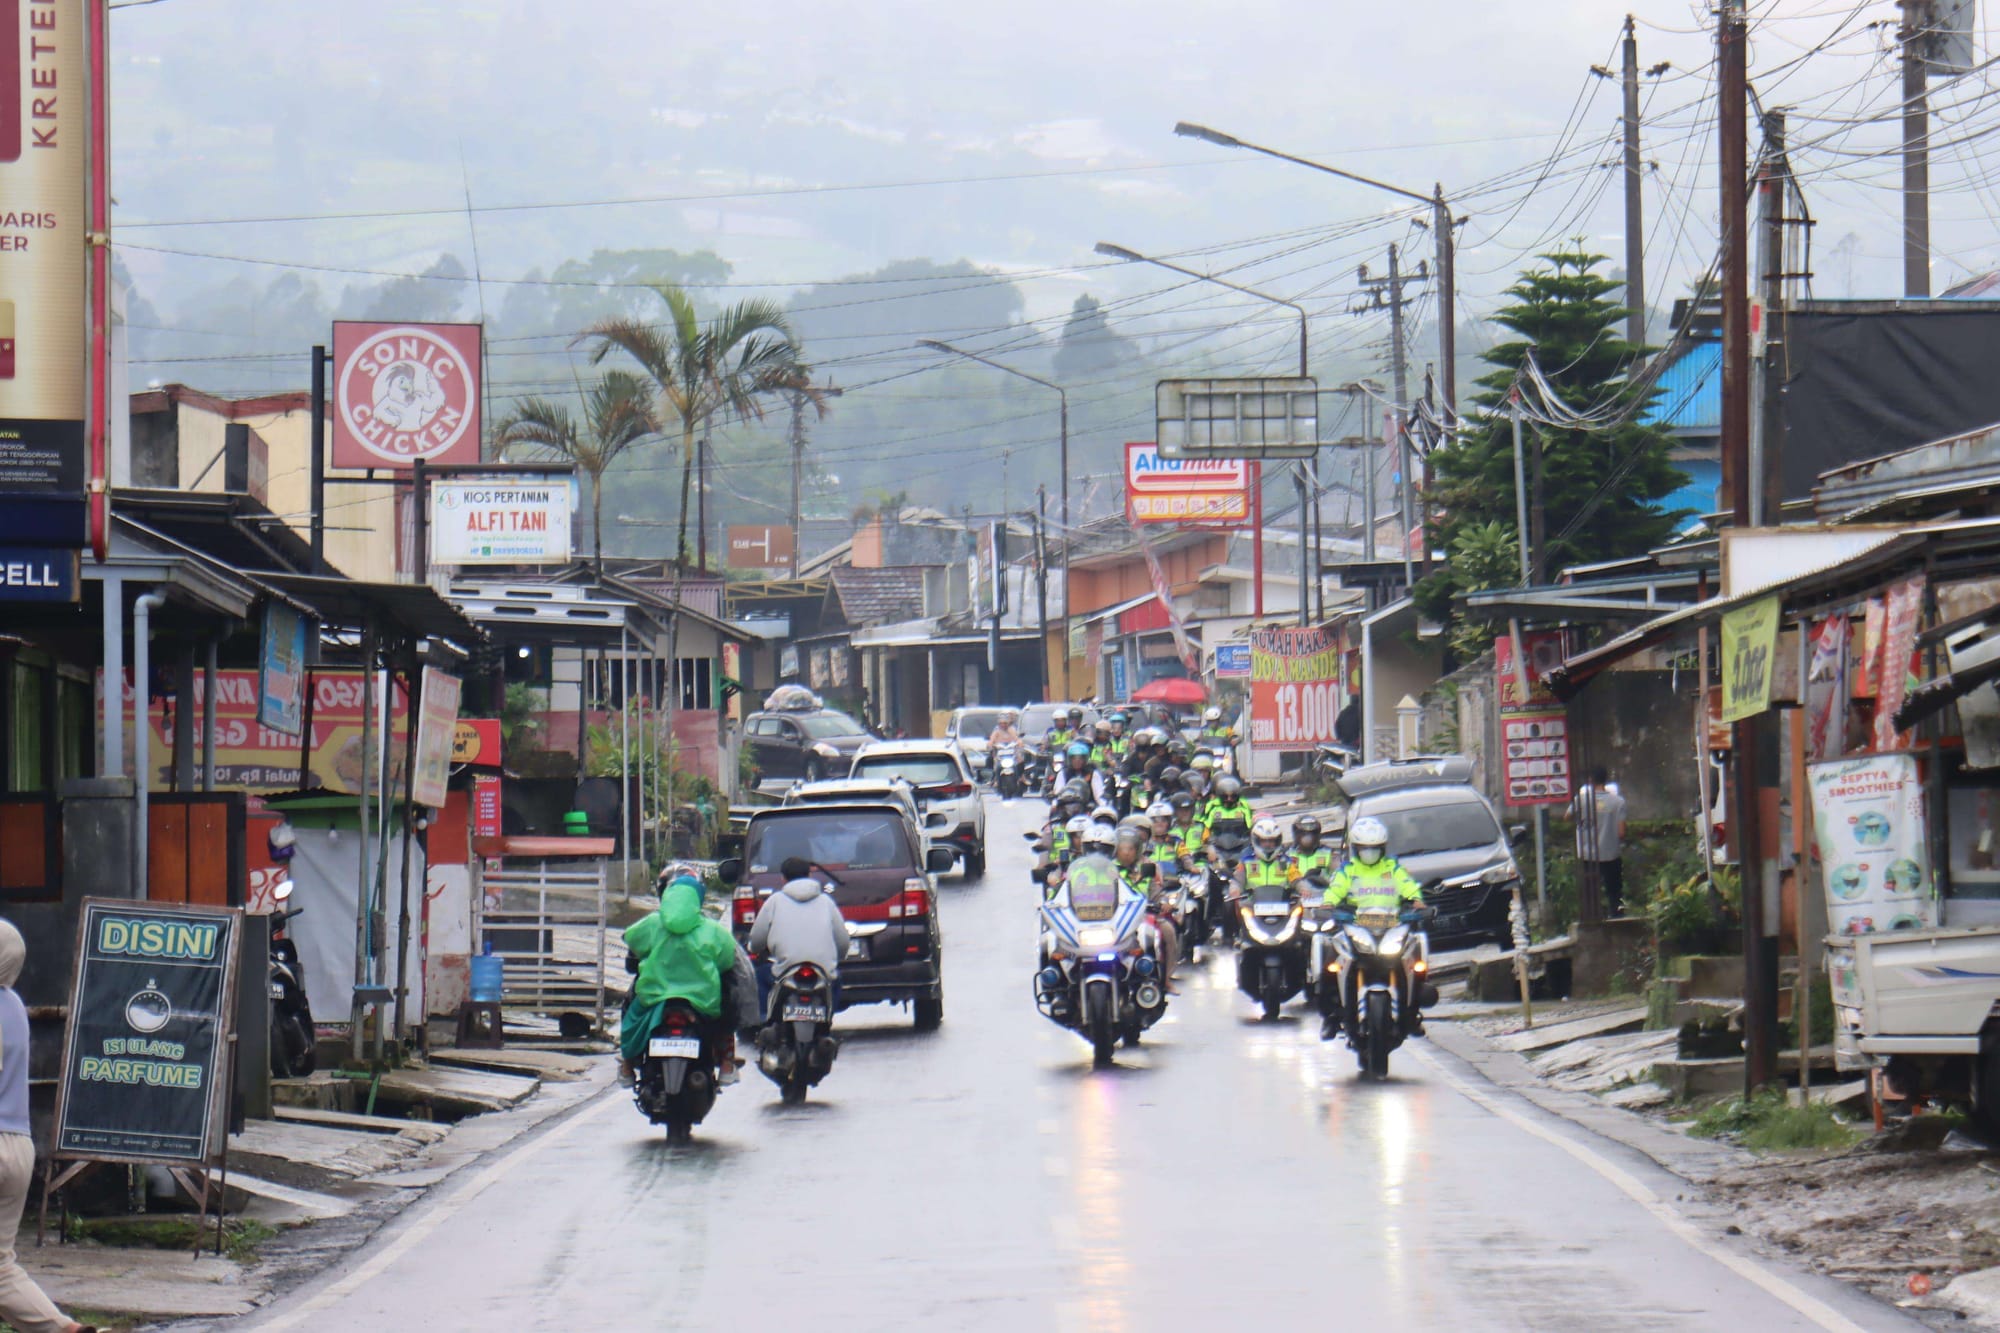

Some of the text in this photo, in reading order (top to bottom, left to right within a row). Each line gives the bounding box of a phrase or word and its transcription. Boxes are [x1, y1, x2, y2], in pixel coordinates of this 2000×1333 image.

[30, 0, 58, 149] KRETE
[0, 212, 57, 229] ARIS
[358, 339, 455, 378] SONIC
[352, 404, 462, 454] CHICKEN
[463, 491, 550, 504] KIOS PERTANIAN
[467, 511, 547, 531] ALFI TANI
[0, 564, 59, 587] ELL
[1252, 630, 1337, 656] RUMAH MAKA
[1275, 682, 1339, 741] 13.000
[1829, 781, 1904, 798] SMOOTHIES
[1840, 770, 1889, 785] SEPTYA
[100, 919, 217, 958] DISINI
[104, 1039, 184, 1060] ISI ULANG
[80, 1058, 202, 1088] PARFUME
